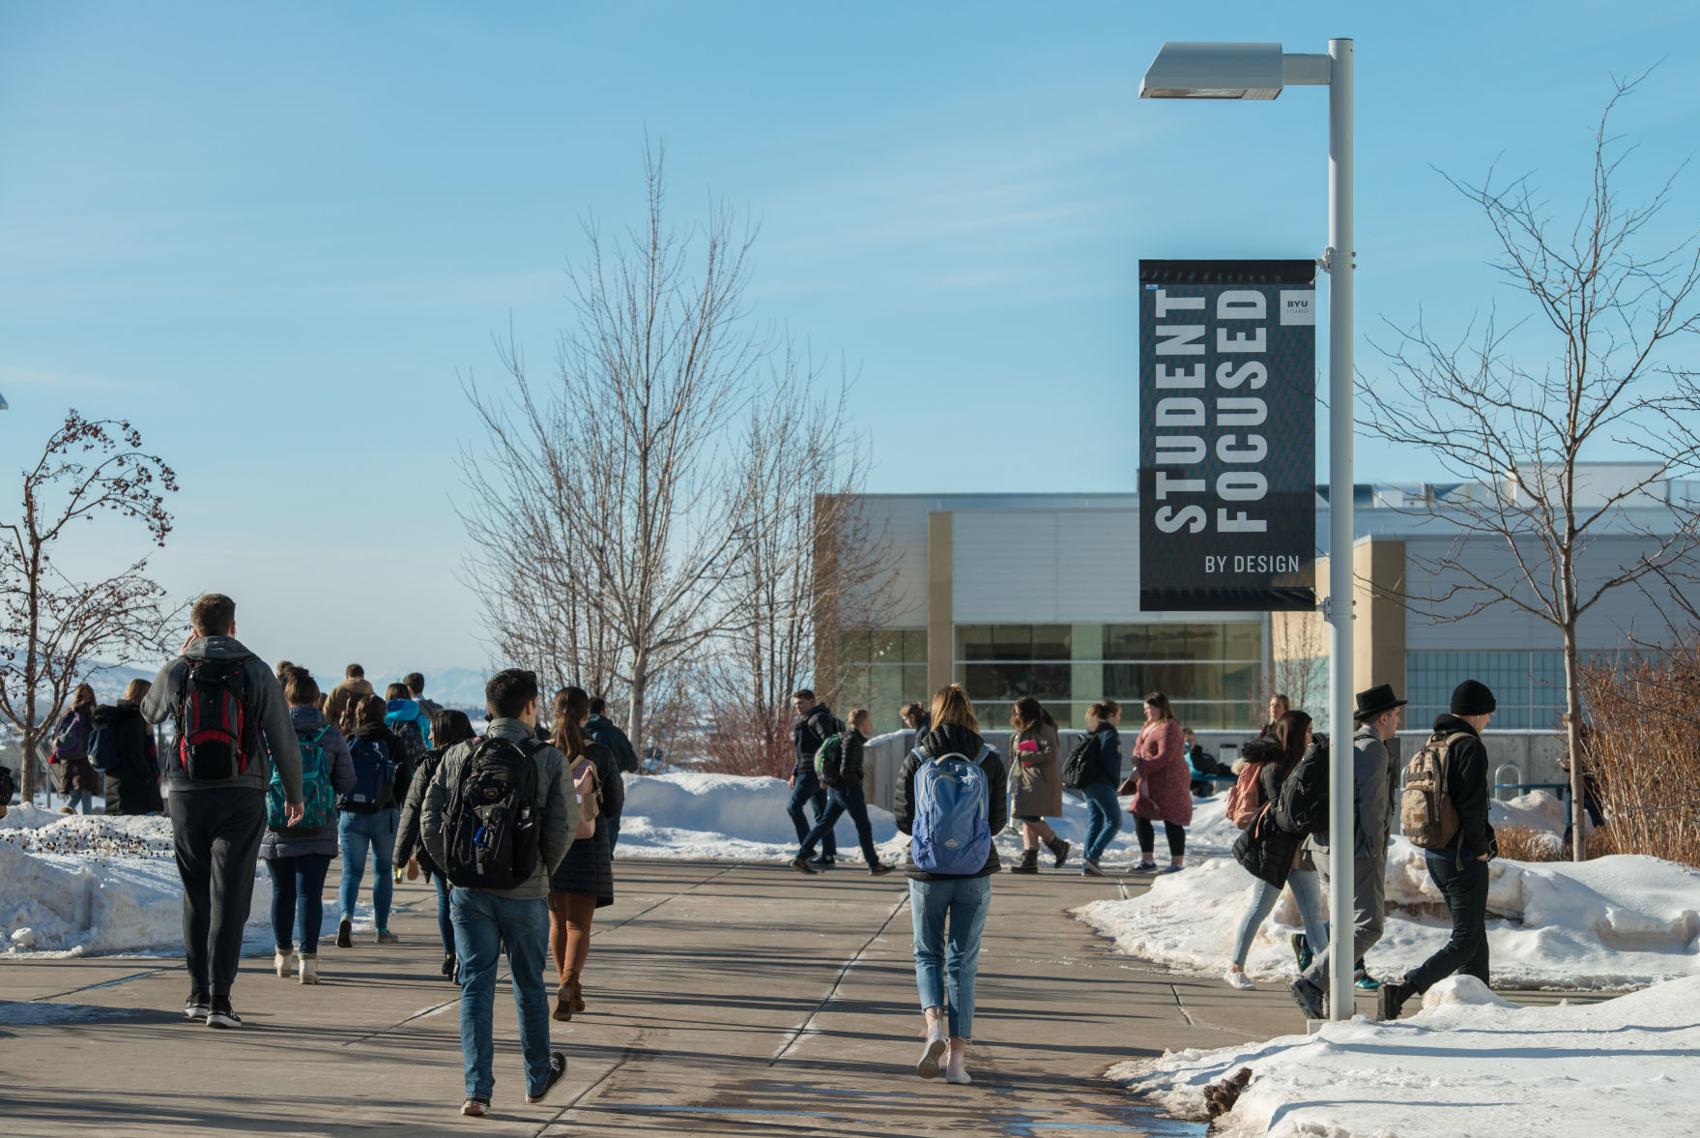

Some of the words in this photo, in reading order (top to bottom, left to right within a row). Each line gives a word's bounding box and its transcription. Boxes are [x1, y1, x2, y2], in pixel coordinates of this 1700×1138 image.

[1155, 289, 1207, 534] STUDENT
[1216, 289, 1268, 533] FOCUSED
[1205, 555, 1227, 573] BY
[1234, 555, 1299, 573] DESIGN
